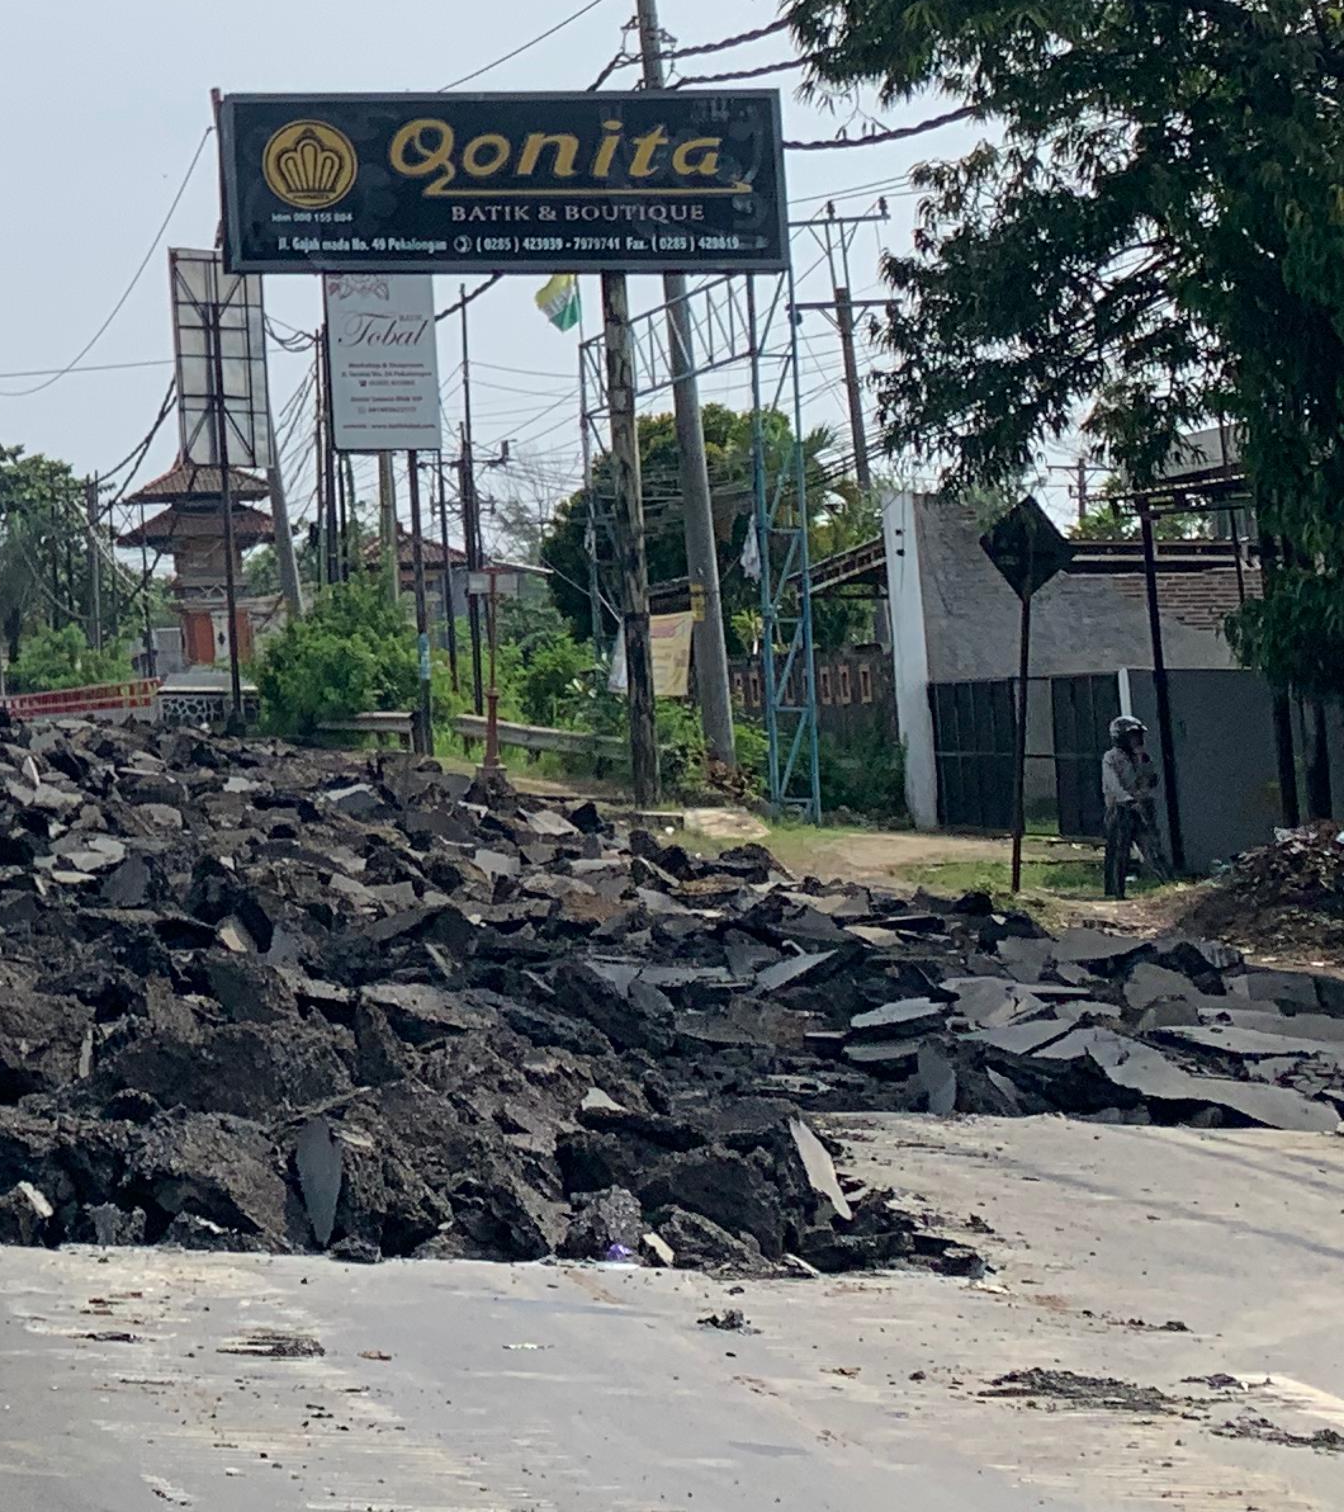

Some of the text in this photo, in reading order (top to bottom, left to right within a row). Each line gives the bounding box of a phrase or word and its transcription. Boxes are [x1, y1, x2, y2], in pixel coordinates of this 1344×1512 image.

[391, 118, 722, 192] Qonita
[451, 204, 706, 225] BATIK & BOUTIQUE
[388, 237, 448, 254] Pekalongan
[337, 310, 428, 348] Tobal
